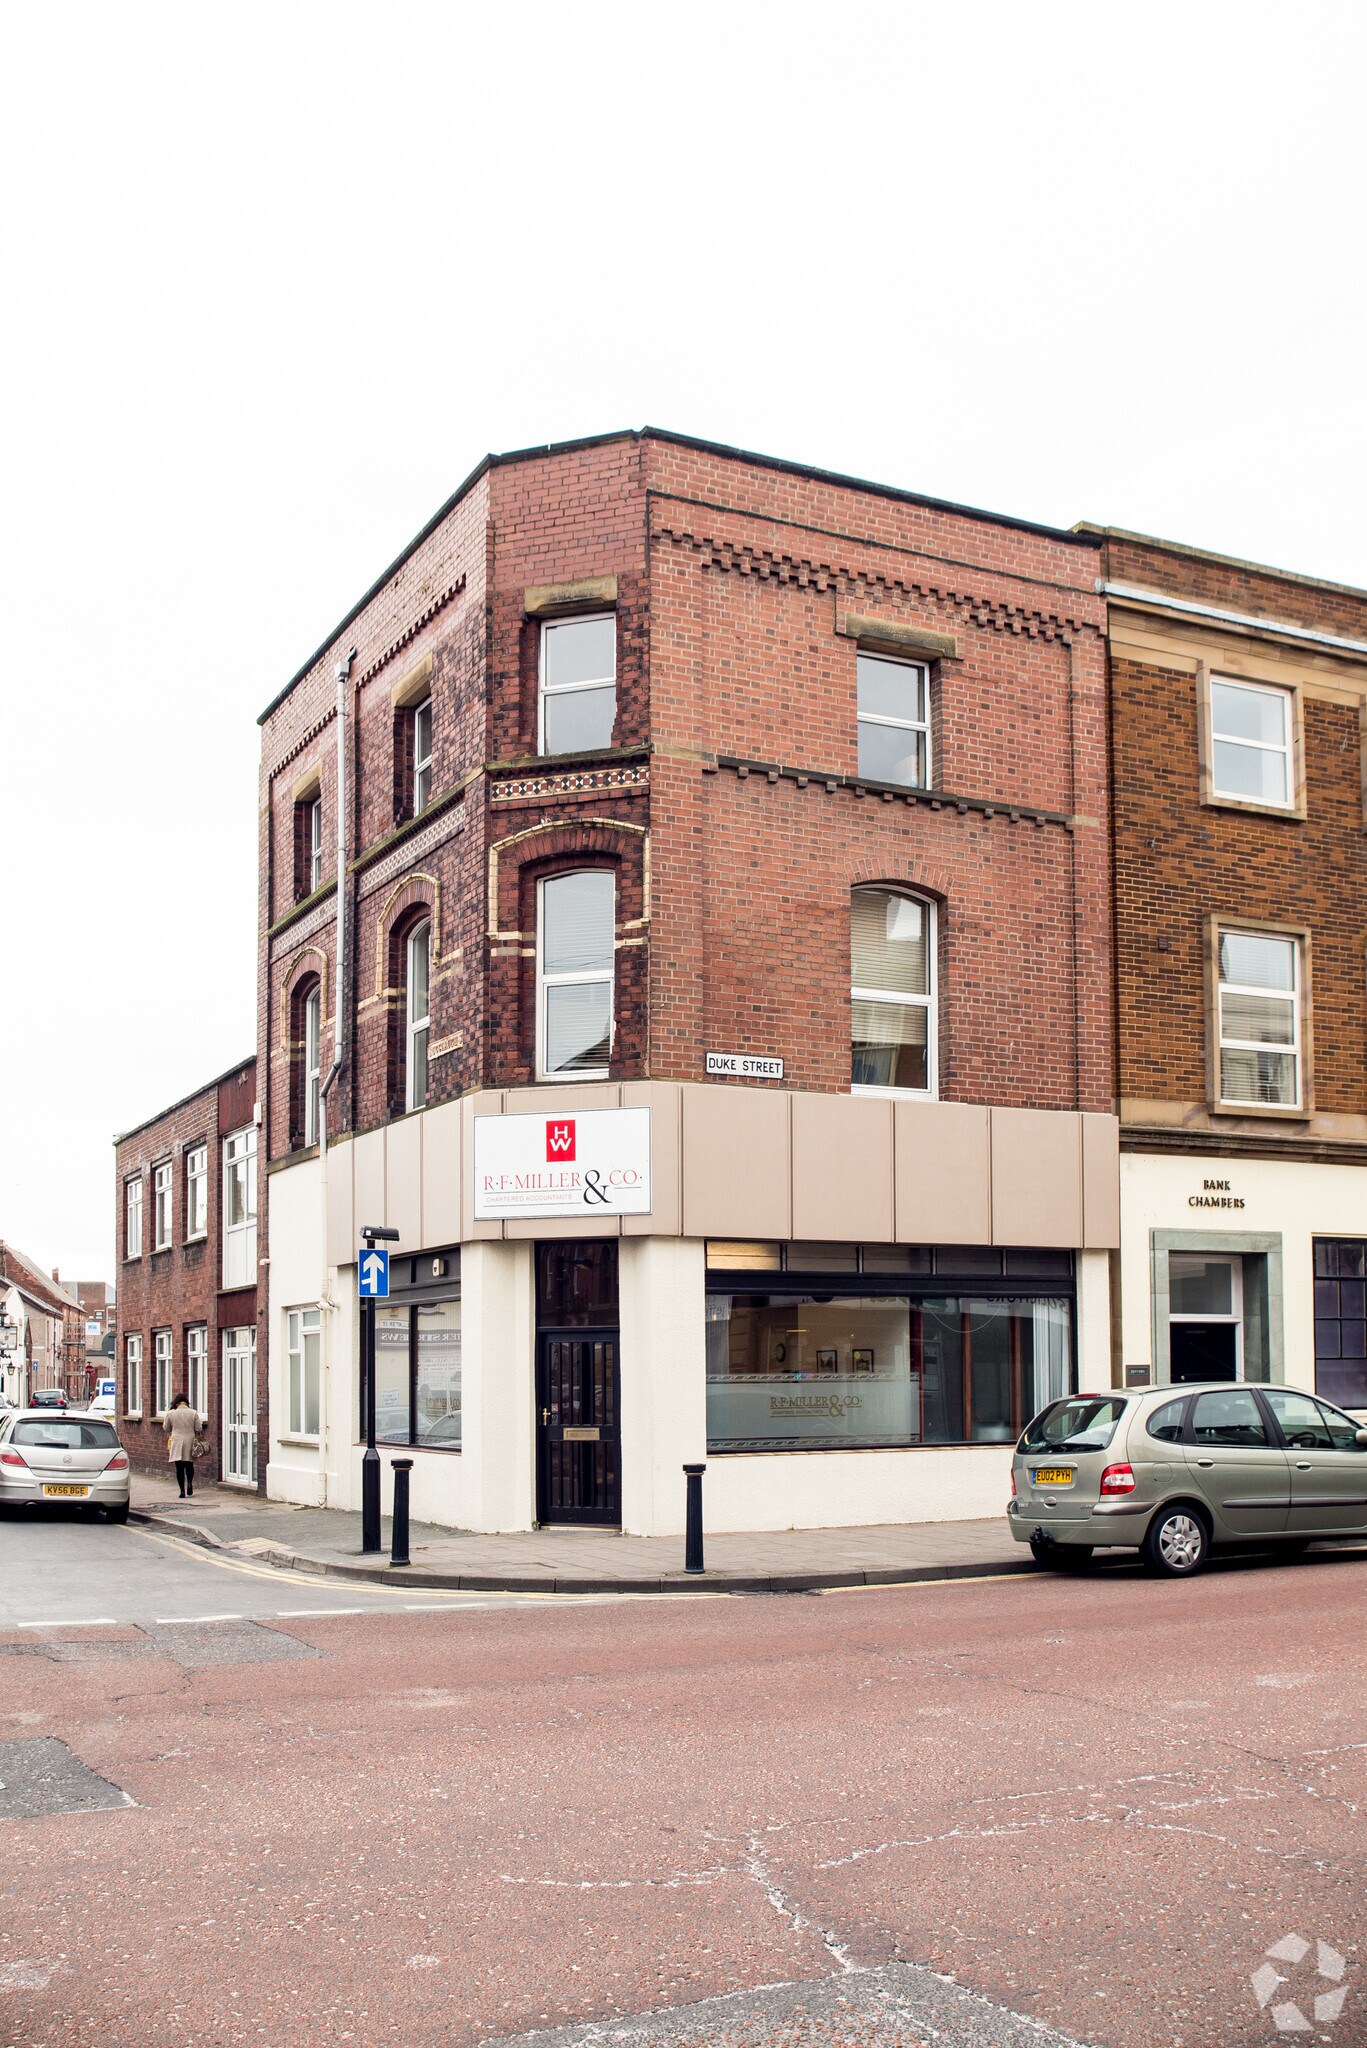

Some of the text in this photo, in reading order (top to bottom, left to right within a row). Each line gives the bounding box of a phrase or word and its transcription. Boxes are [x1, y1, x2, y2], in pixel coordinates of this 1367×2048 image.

[708, 1057, 781, 1074] DUKE STREET
[1203, 1179, 1231, 1191] BANK
[485, 1193, 573, 1204] CHARTERED ACCOUNTANTS
[1188, 1196, 1246, 1209] CHAMBERS
[1036, 1470, 1071, 1481] EU02 PYH
[47, 1486, 69, 1494] KV56
